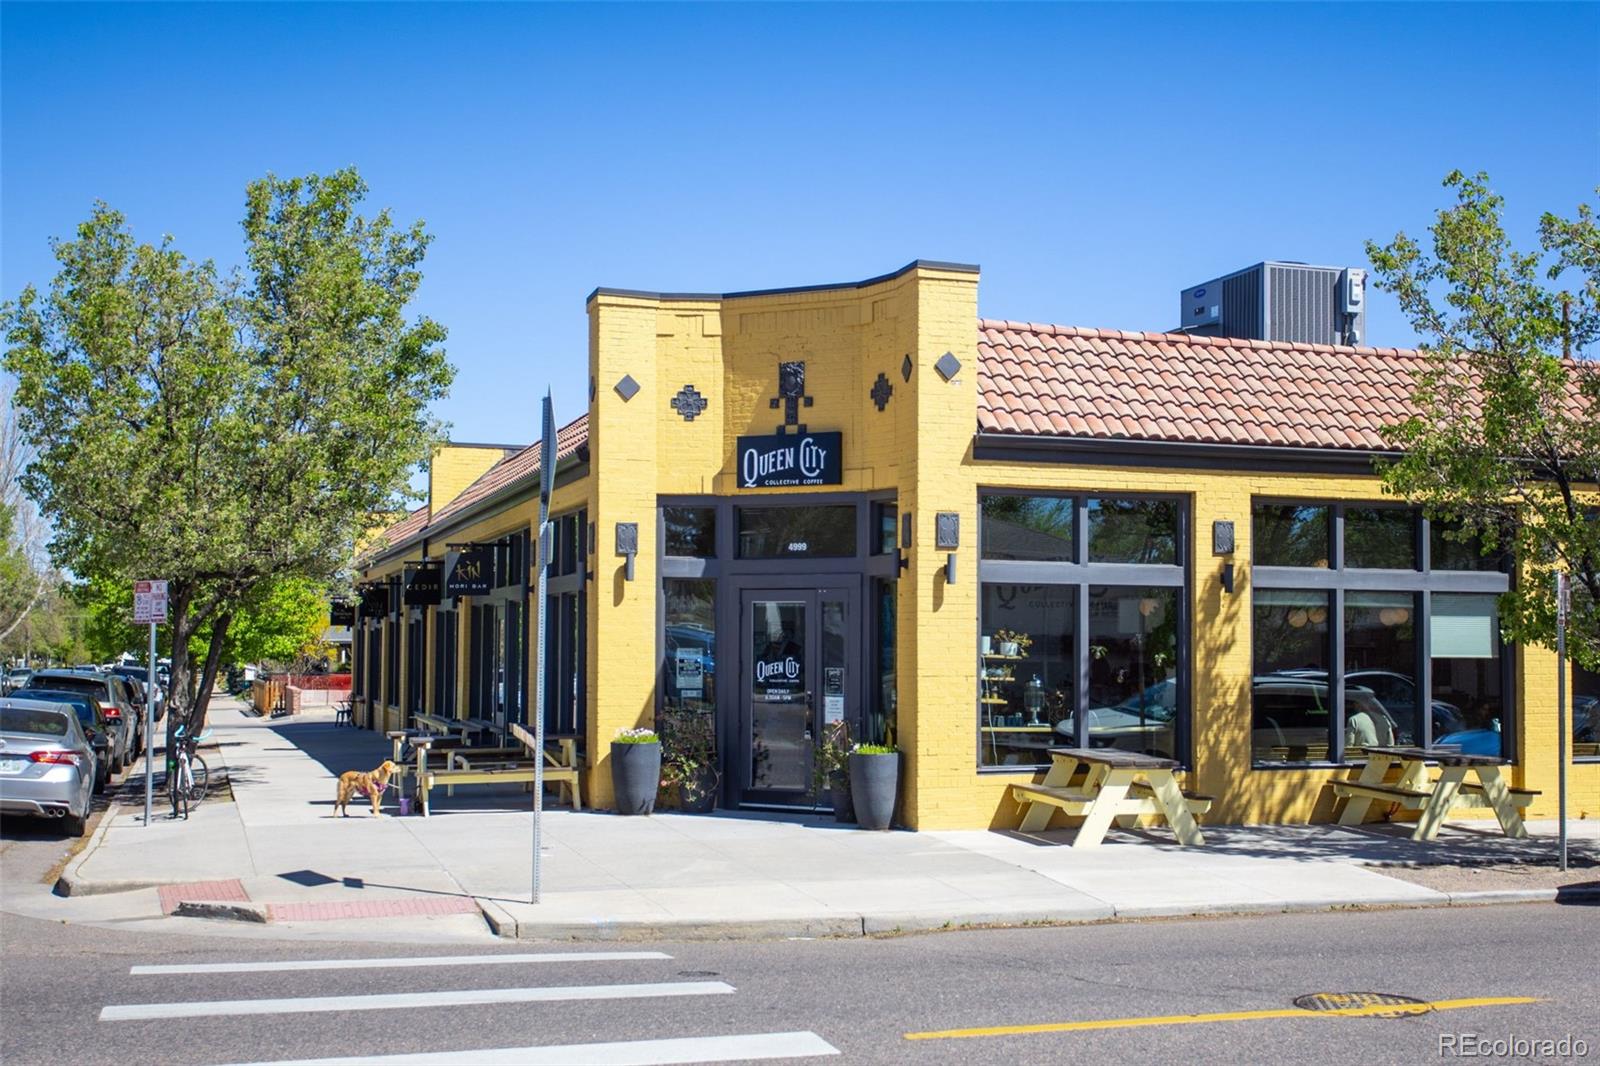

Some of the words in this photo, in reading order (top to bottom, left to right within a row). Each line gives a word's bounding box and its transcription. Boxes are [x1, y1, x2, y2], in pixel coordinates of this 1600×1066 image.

[743, 447, 794, 488] QUEEN
[800, 437, 827, 477] CITY
[788, 542, 807, 551] 4999
[756, 660, 784, 682] QUEEN
[785, 656, 800, 678] CITY
